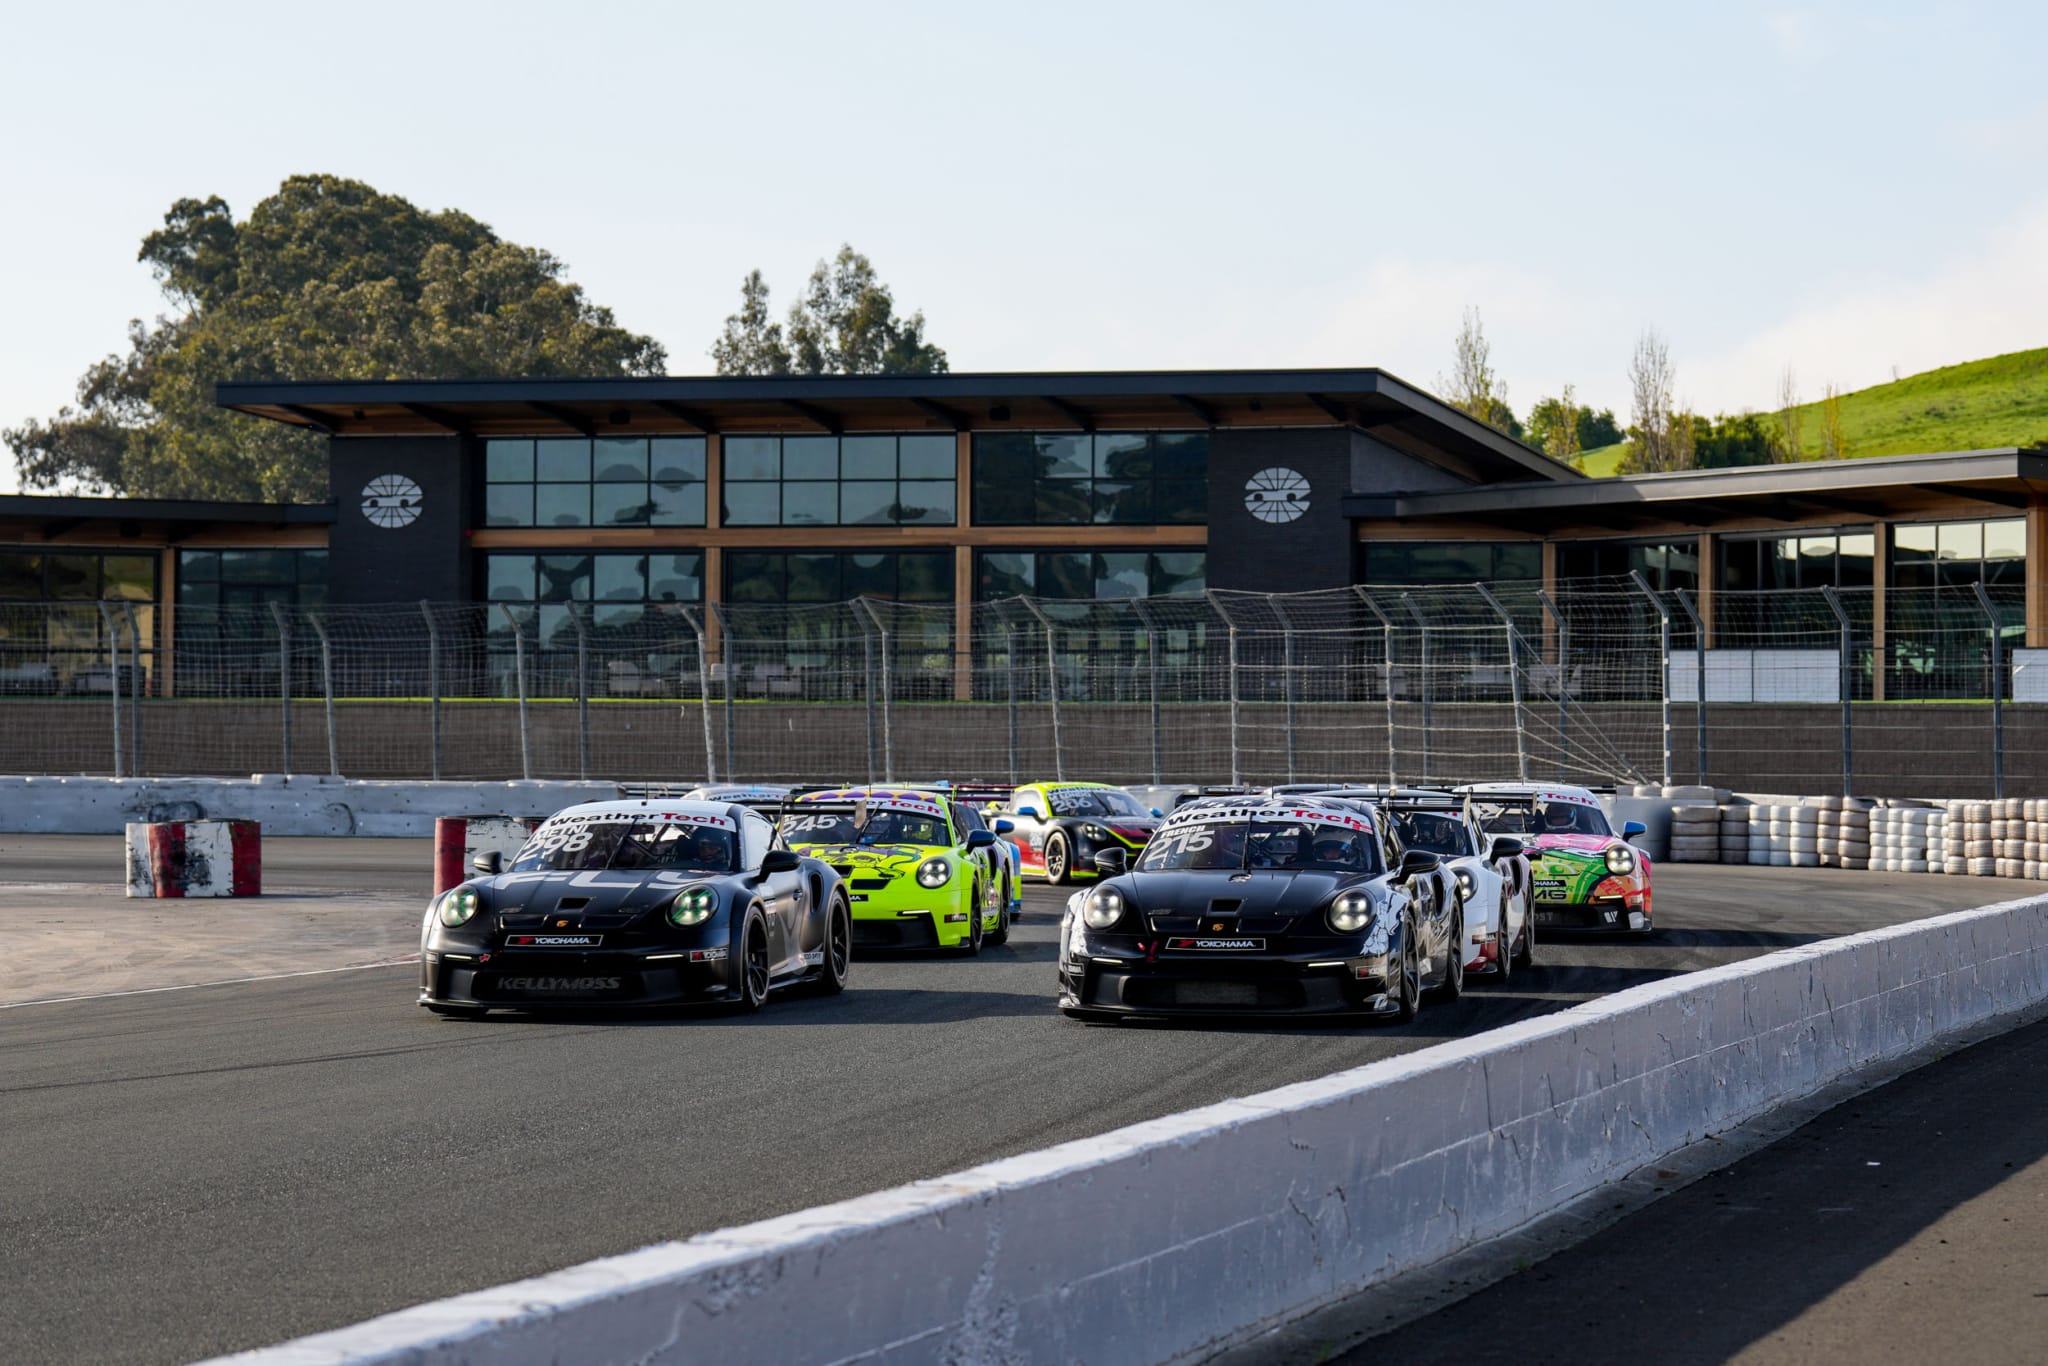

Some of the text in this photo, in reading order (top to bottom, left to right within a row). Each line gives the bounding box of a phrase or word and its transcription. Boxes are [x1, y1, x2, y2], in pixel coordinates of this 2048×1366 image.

[551, 812, 725, 826] WeatherTech
[1168, 809, 1362, 825] WeatherTech
[783, 815, 836, 837] 245
[1161, 825, 1206, 839] FRENCH
[516, 832, 593, 863] 298
[1143, 831, 1215, 863] 215
[535, 937, 590, 945] YOKOHAMA
[497, 977, 621, 990] KELLYMOSS
